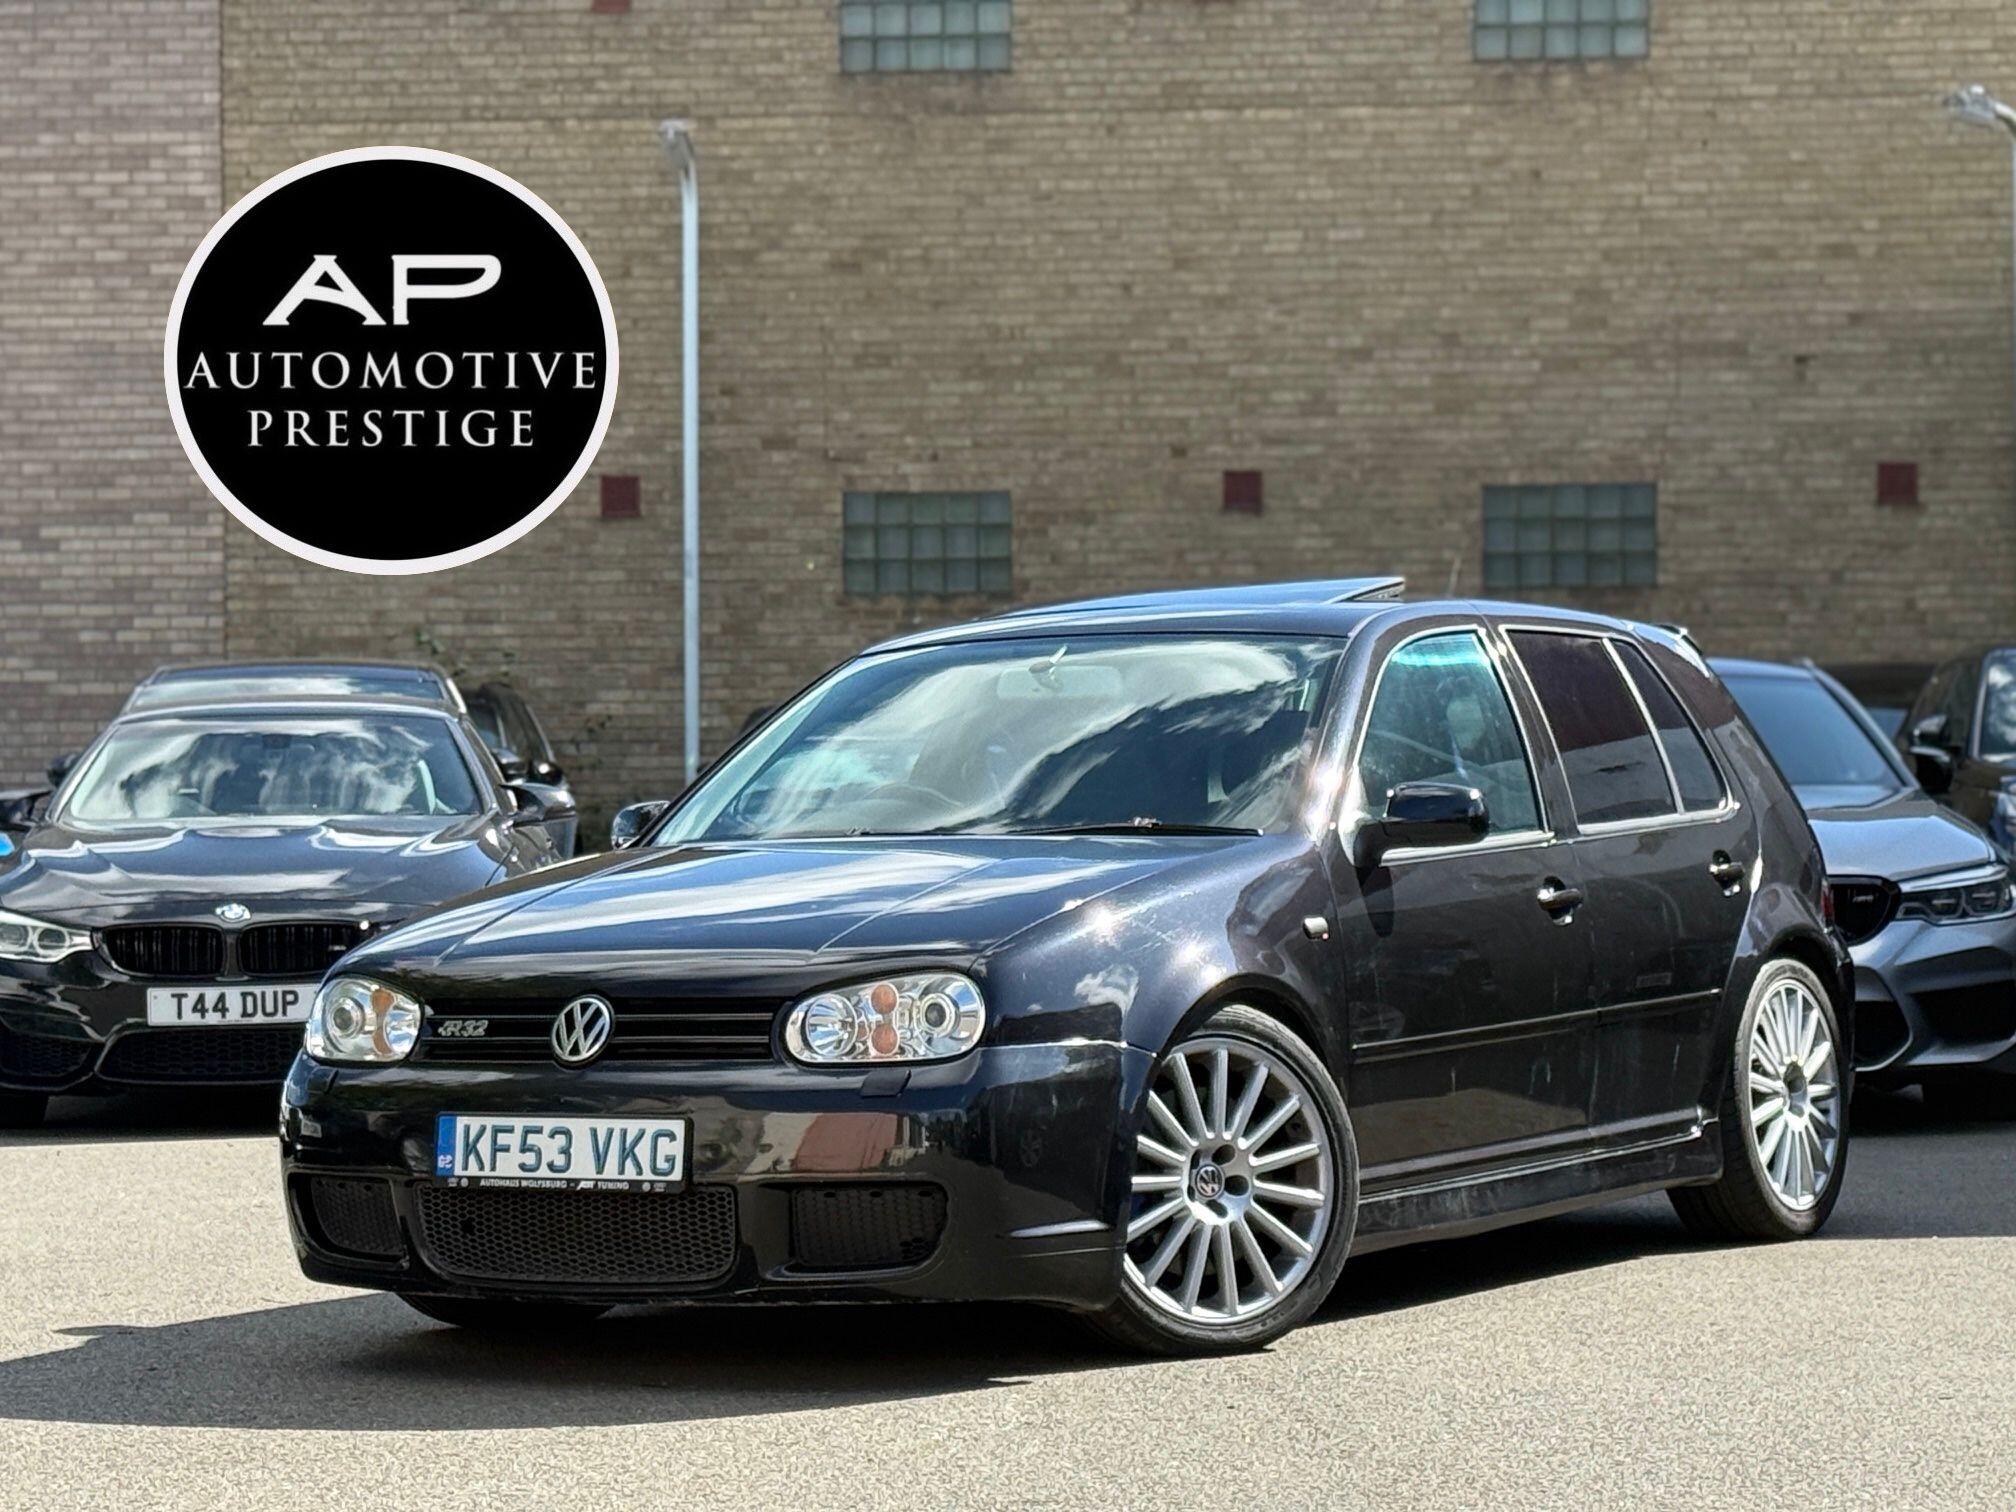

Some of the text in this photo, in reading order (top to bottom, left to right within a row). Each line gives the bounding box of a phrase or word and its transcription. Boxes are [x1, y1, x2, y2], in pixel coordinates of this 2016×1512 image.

[170, 989, 300, 1021] T44 DUP
[461, 1123, 678, 1177] KF53 VKG
